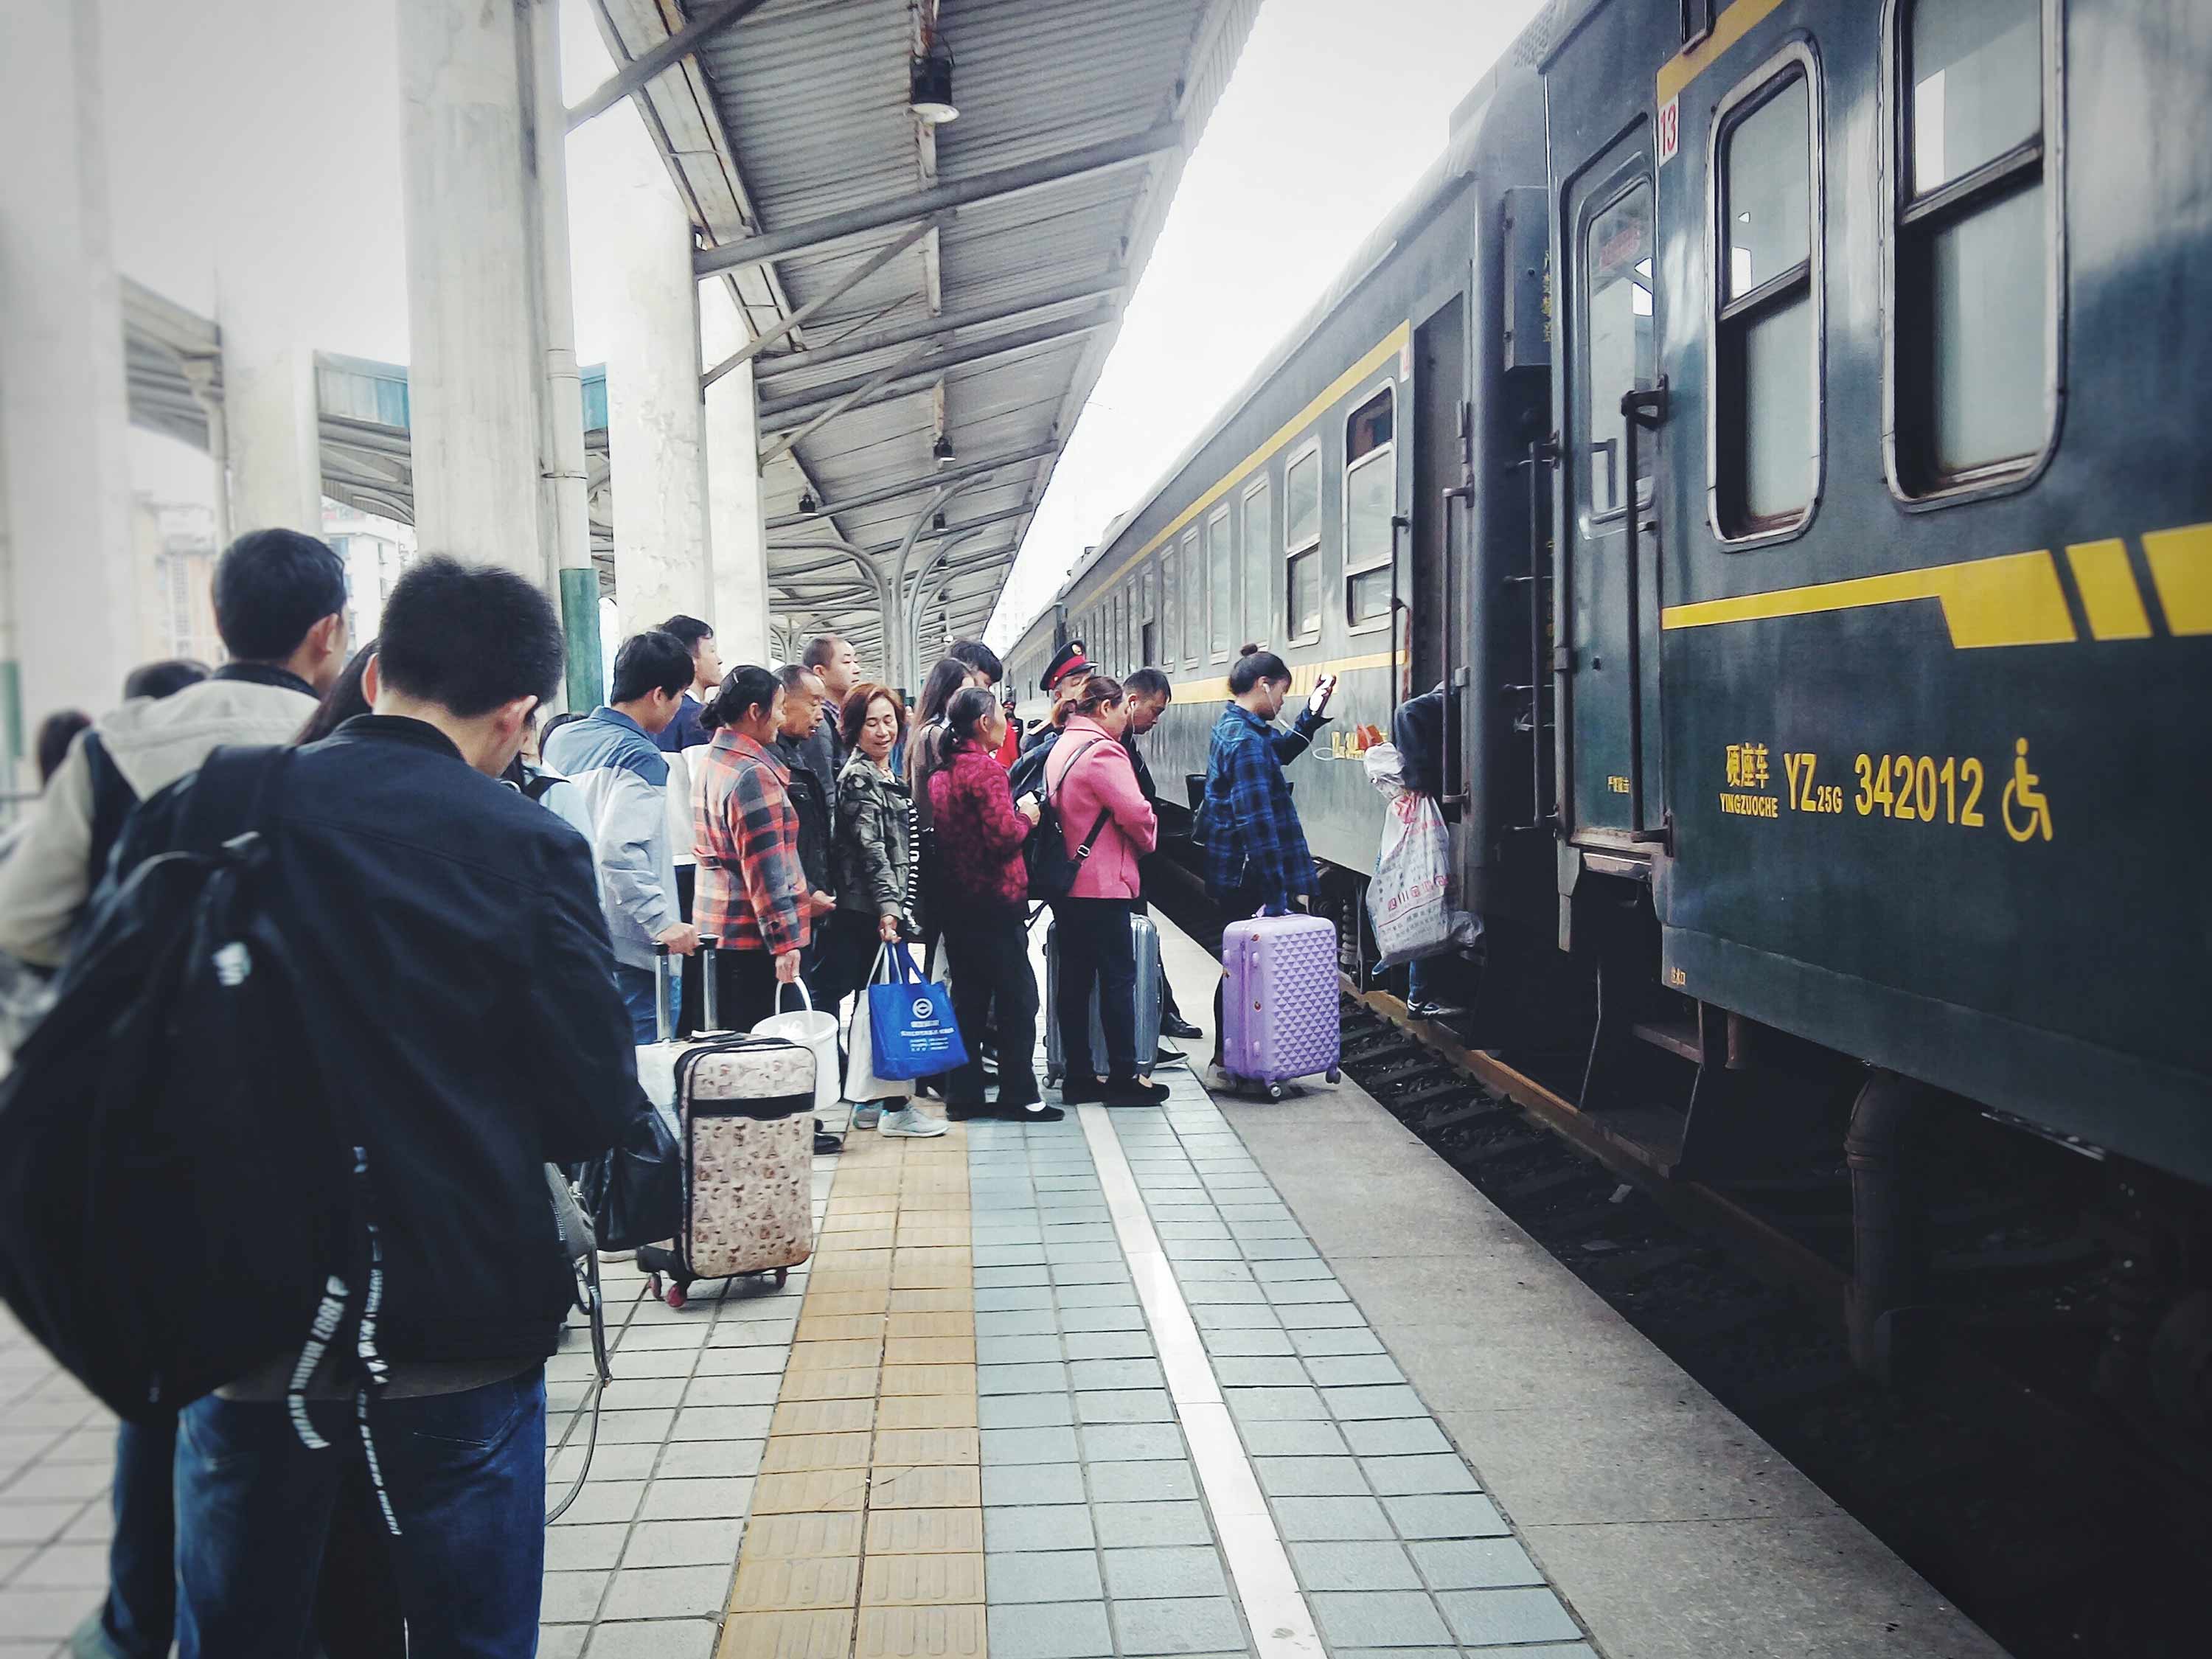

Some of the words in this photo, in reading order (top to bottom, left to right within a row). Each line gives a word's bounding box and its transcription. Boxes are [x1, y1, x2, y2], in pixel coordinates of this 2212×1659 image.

[1660, 104, 1677, 156] 13
[1725, 742, 1770, 789] 硬座车
[1854, 753, 1985, 827] 342012
[1719, 793, 1778, 818] YINGZUOCHE
